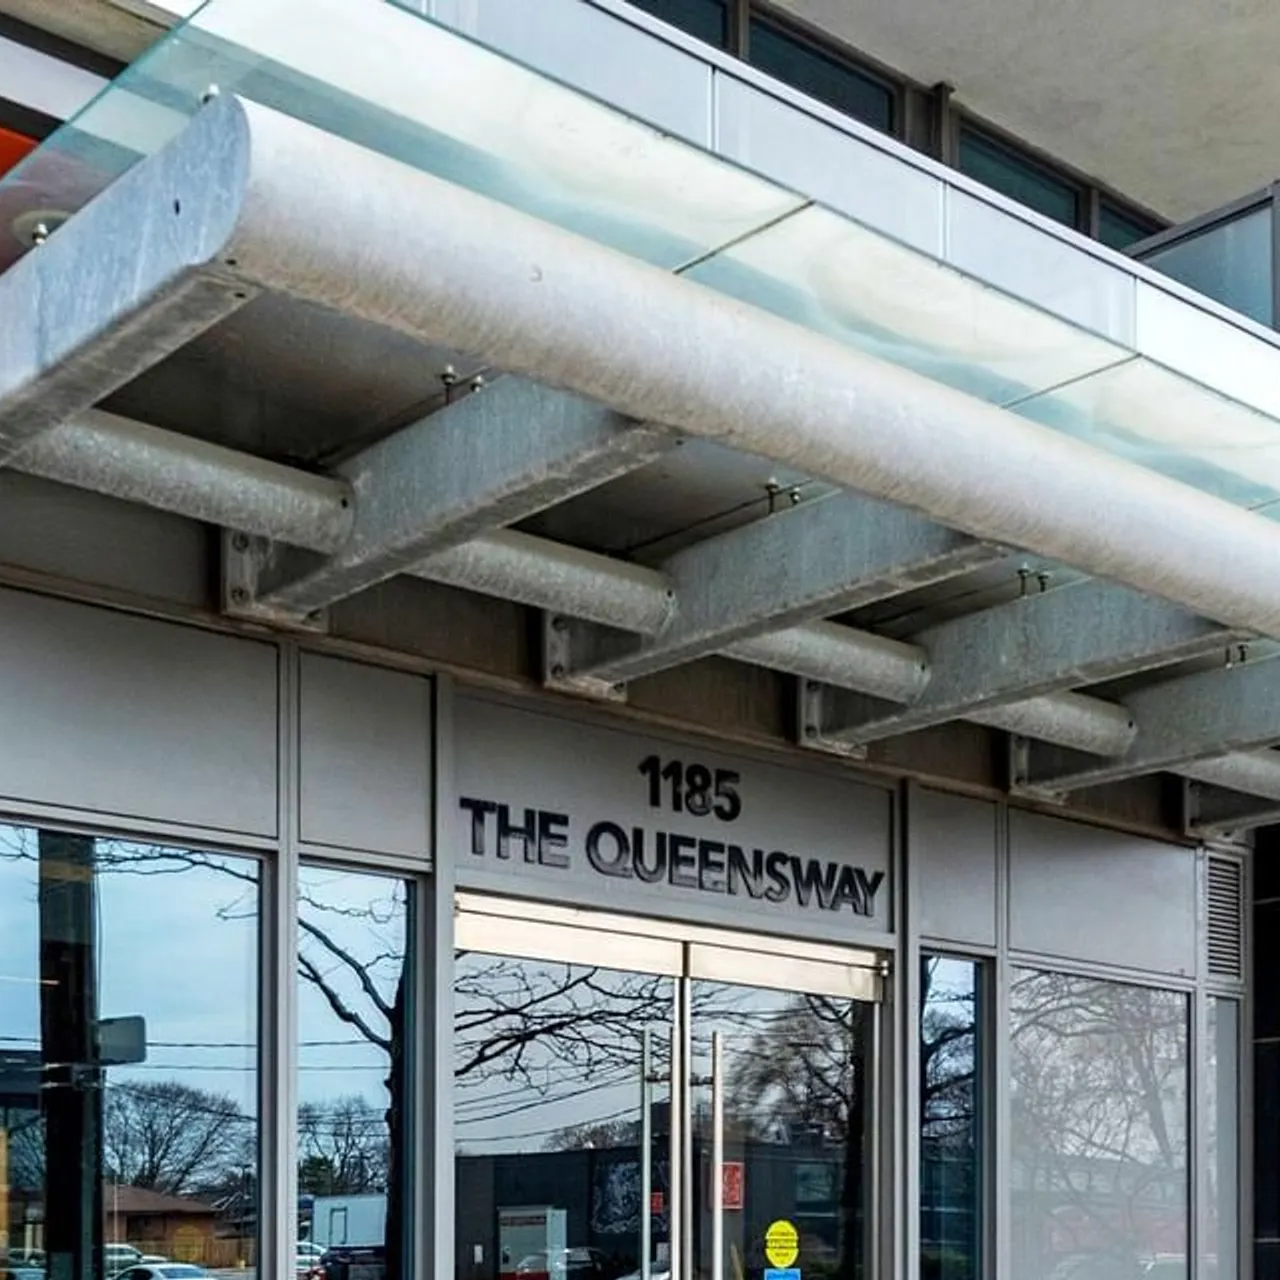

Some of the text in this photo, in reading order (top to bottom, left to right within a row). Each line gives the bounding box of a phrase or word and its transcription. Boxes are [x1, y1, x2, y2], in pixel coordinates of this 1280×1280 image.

[638, 755, 742, 822] 1185
[459, 797, 885, 917] THE QUEENSWAY
